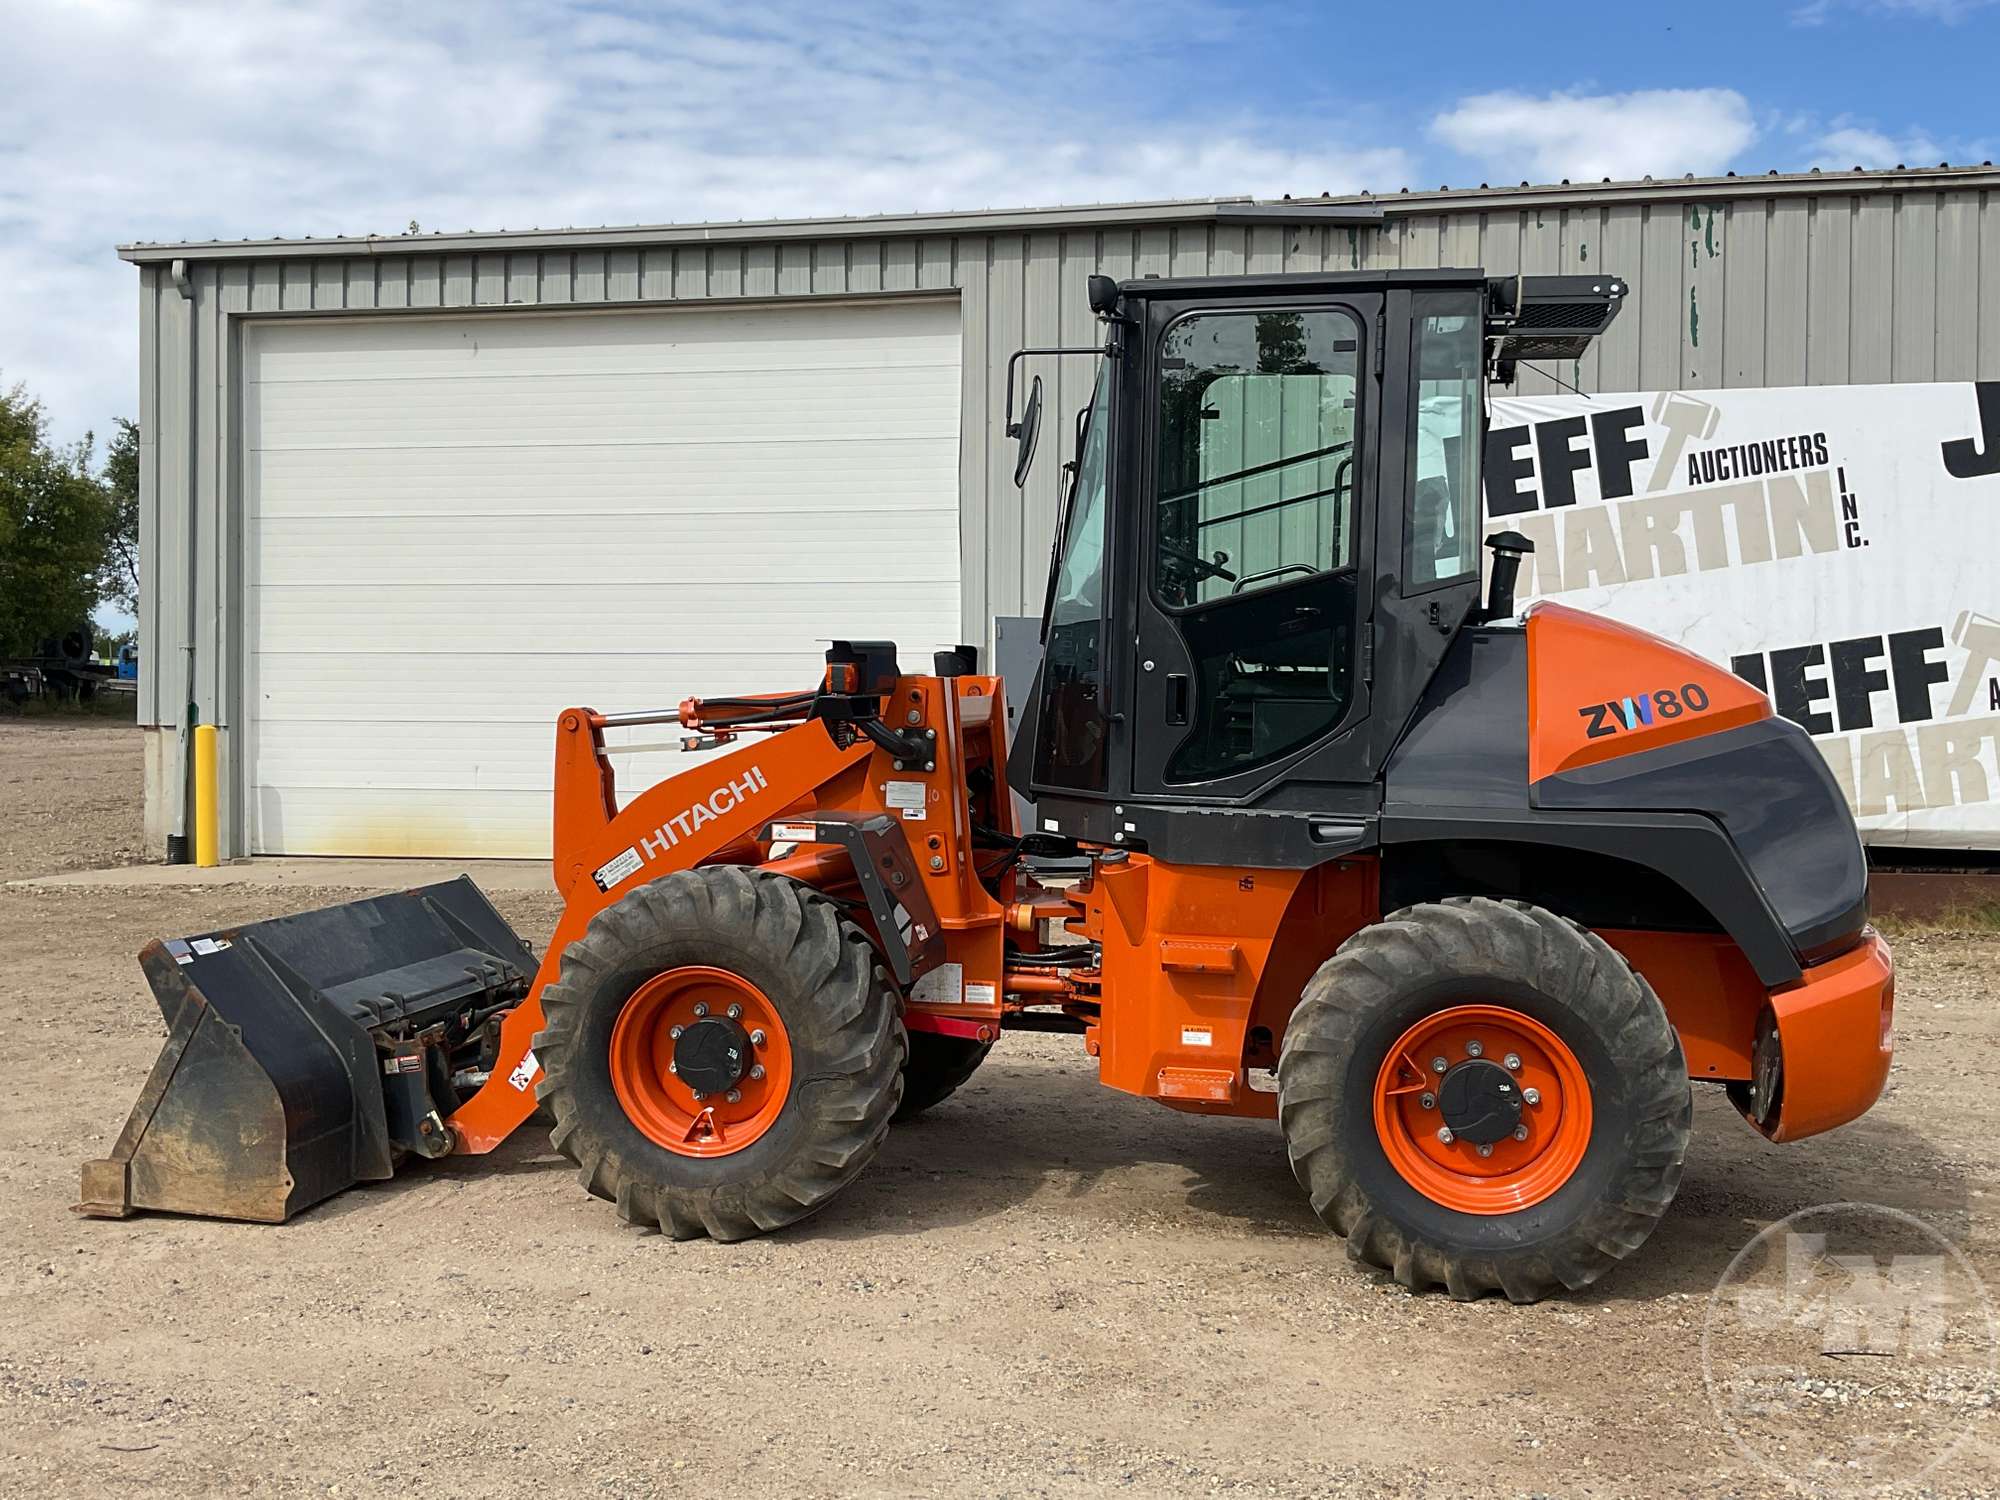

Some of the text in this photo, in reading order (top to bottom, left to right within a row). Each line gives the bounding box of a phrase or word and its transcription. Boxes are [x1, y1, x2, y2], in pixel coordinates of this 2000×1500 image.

[1688, 432, 1829, 486] AUCTIONEERS
[1837, 466, 1870, 549] INC.
[1579, 683, 1710, 739] ZW80
[640, 765, 768, 860] HITACHI
